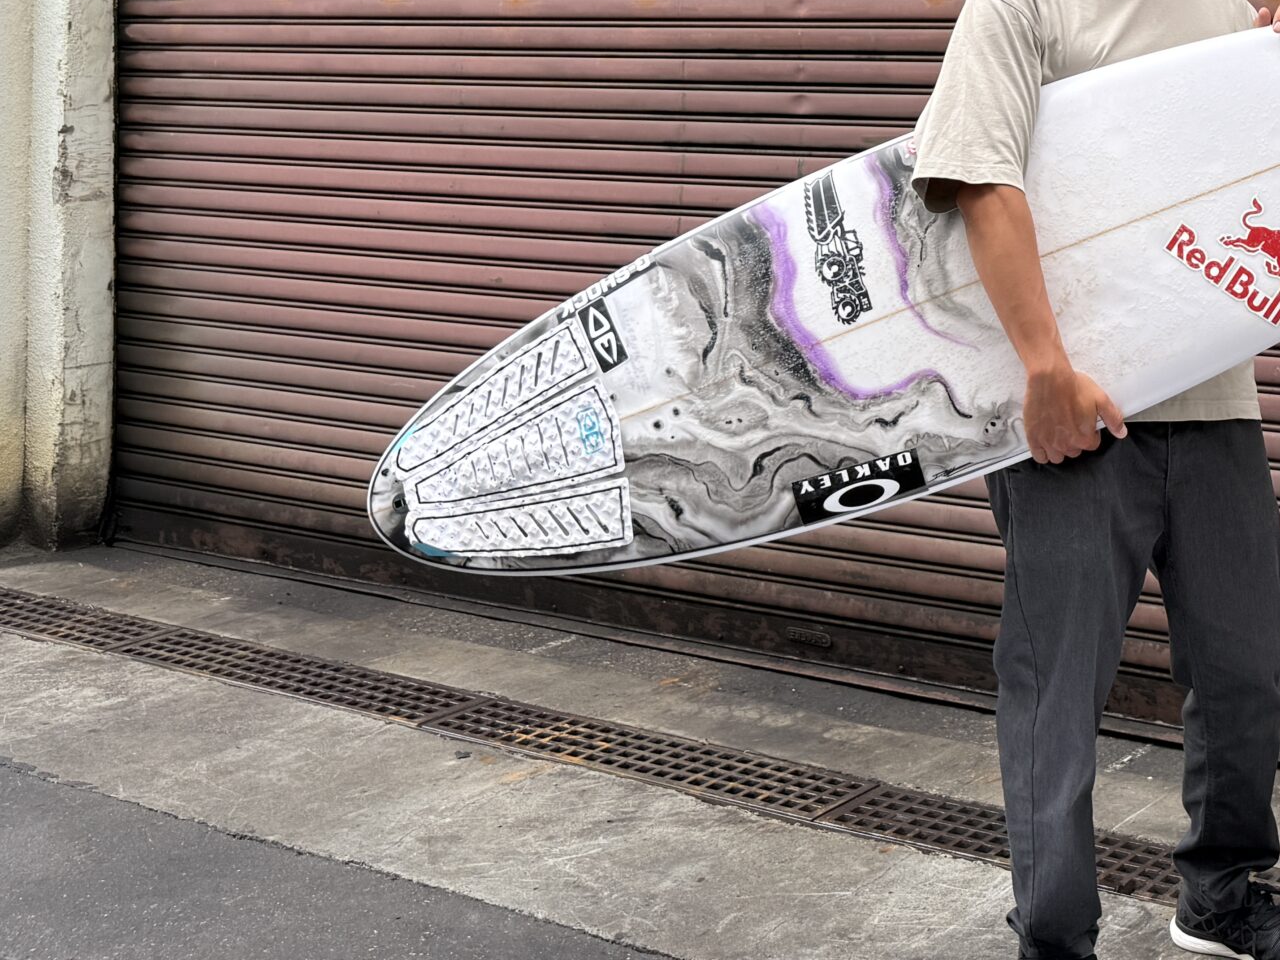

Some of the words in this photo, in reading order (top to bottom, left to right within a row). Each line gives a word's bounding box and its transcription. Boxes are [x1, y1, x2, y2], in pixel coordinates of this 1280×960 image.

[560, 253, 652, 319] G-SHOCK
[1165, 223, 1236, 286] Red
[799, 450, 914, 495] OAKLEY
